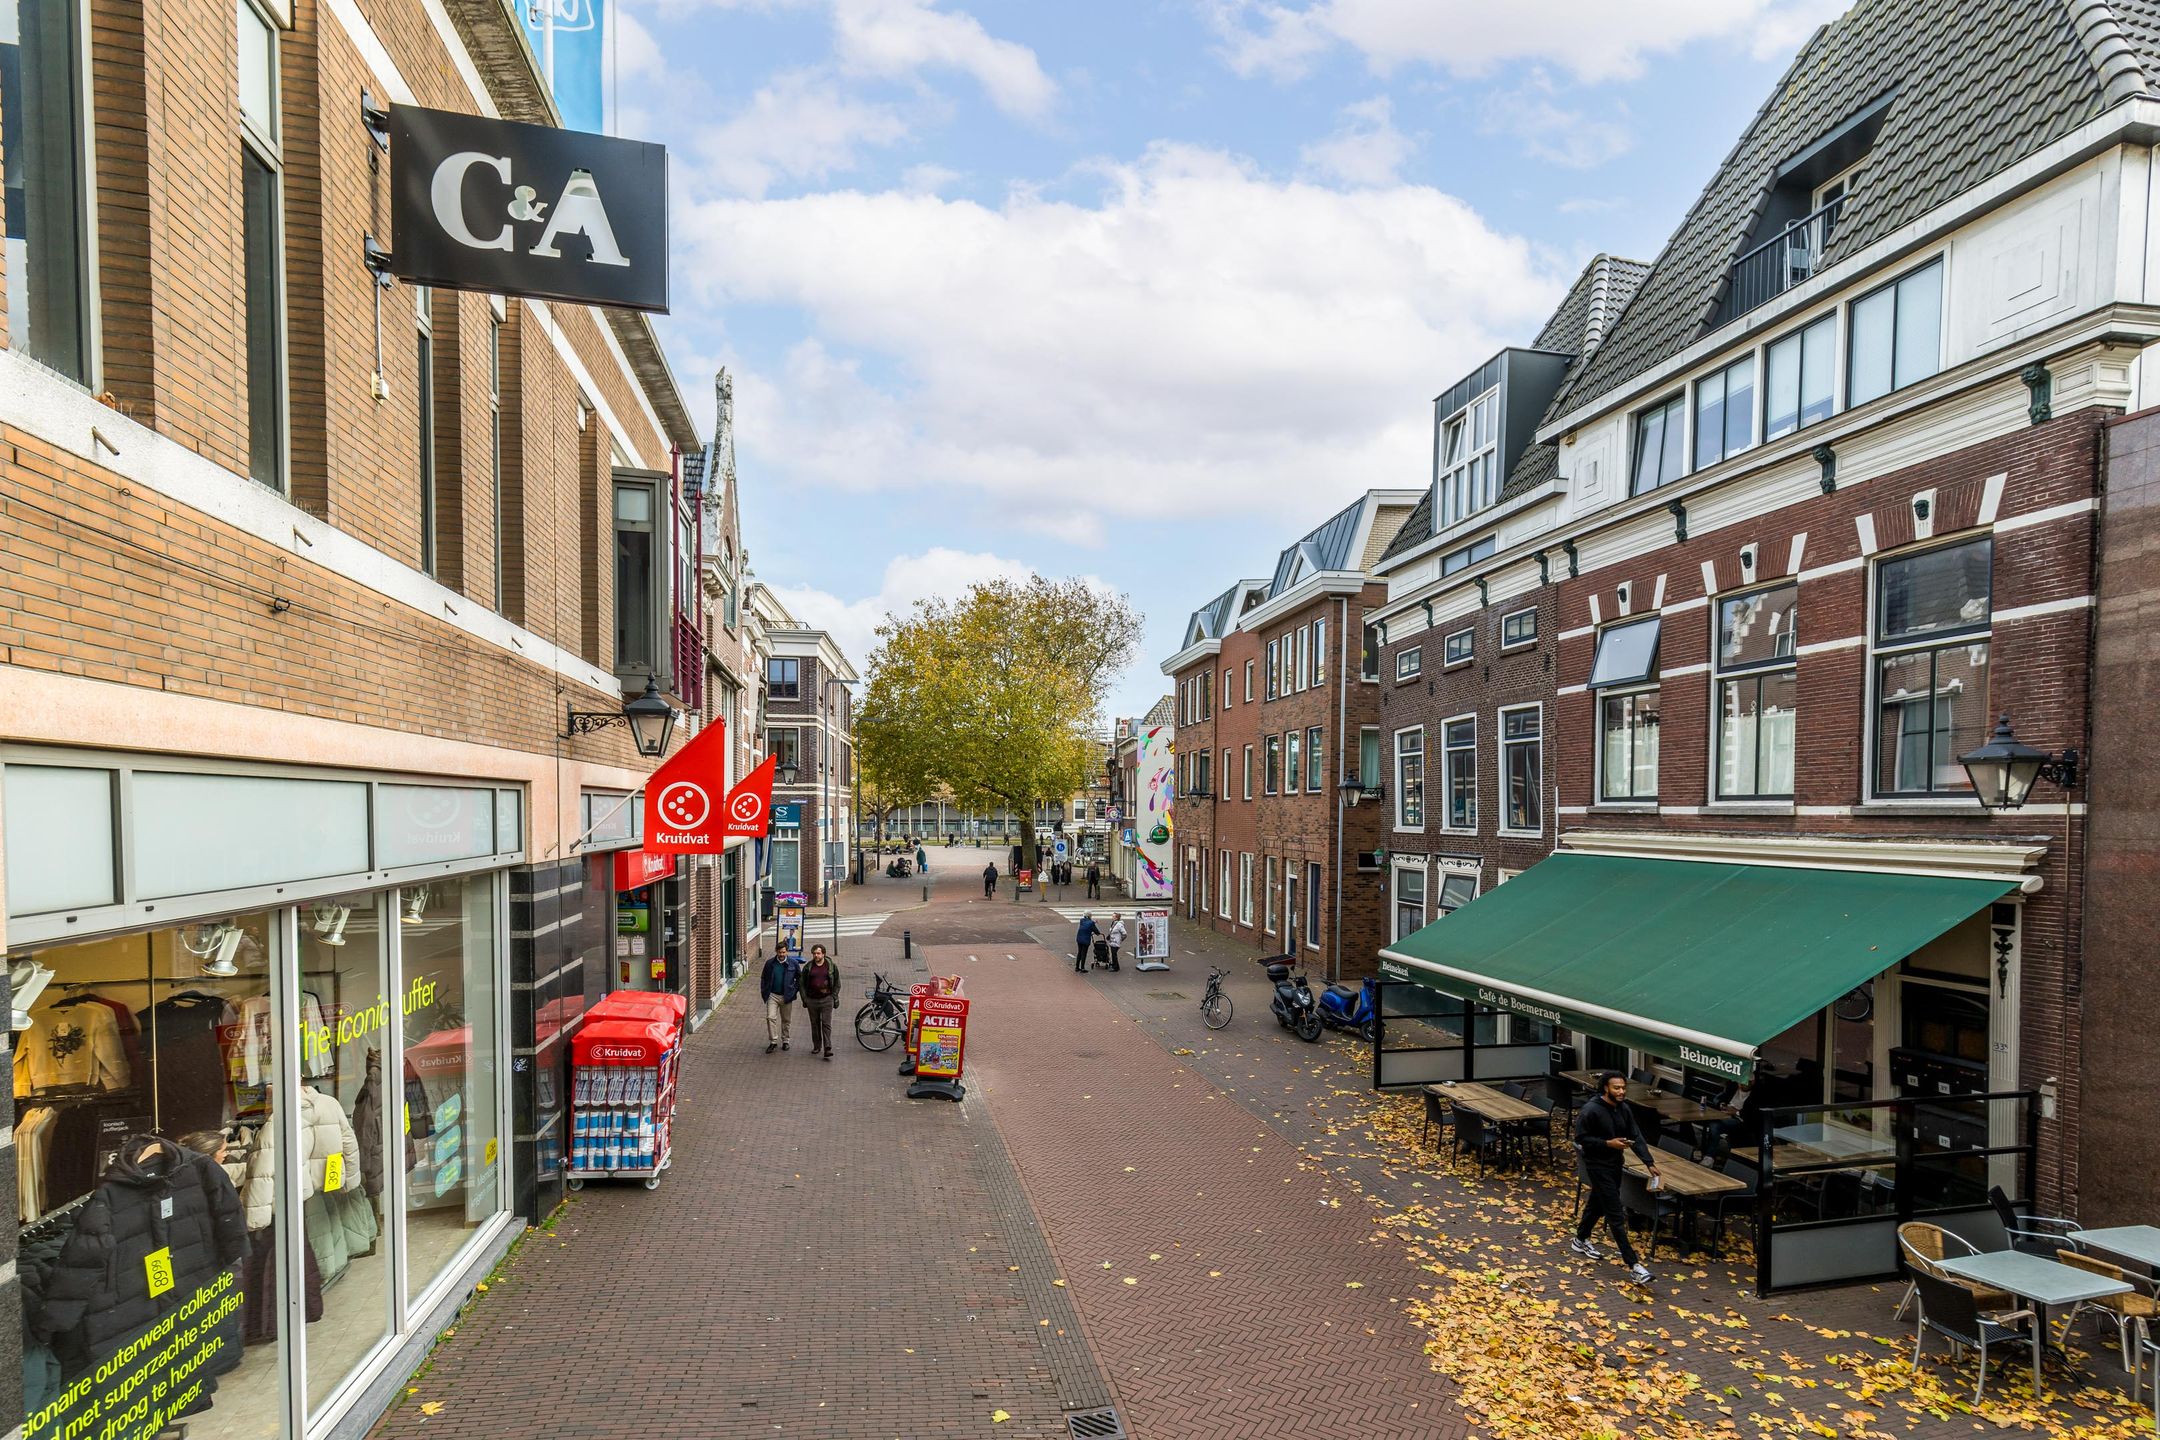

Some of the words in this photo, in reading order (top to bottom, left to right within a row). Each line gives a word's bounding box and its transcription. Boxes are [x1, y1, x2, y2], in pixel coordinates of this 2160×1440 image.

[430, 151, 631, 267] C&A
[656, 832, 710, 845] Kruidvat
[728, 823, 759, 831] Kruidvat
[1382, 961, 1409, 977] Heineken
[336, 994, 389, 1046] iconic
[923, 1016, 959, 1027] ACTIE!
[934, 1001, 960, 1010] Kruidvat
[1478, 988, 1497, 1003] Café
[1498, 995, 1509, 1007] de
[1511, 997, 1562, 1024] Boemerang
[604, 1048, 642, 1057] Kruidvat
[1679, 1045, 1742, 1076] Heineken
[95, 1312, 176, 1384] outerwear
[179, 1271, 233, 1321] collectie
[65, 1401, 101, 1440] met
[104, 1326, 198, 1410] superzachte
[200, 1291, 244, 1334] stoffen
[100, 1398, 148, 1440] droog
[152, 1381, 167, 1403] te
[170, 1335, 225, 1388] houden.
[142, 1408, 165, 1440] elk
[167, 1377, 203, 1422] weer.
